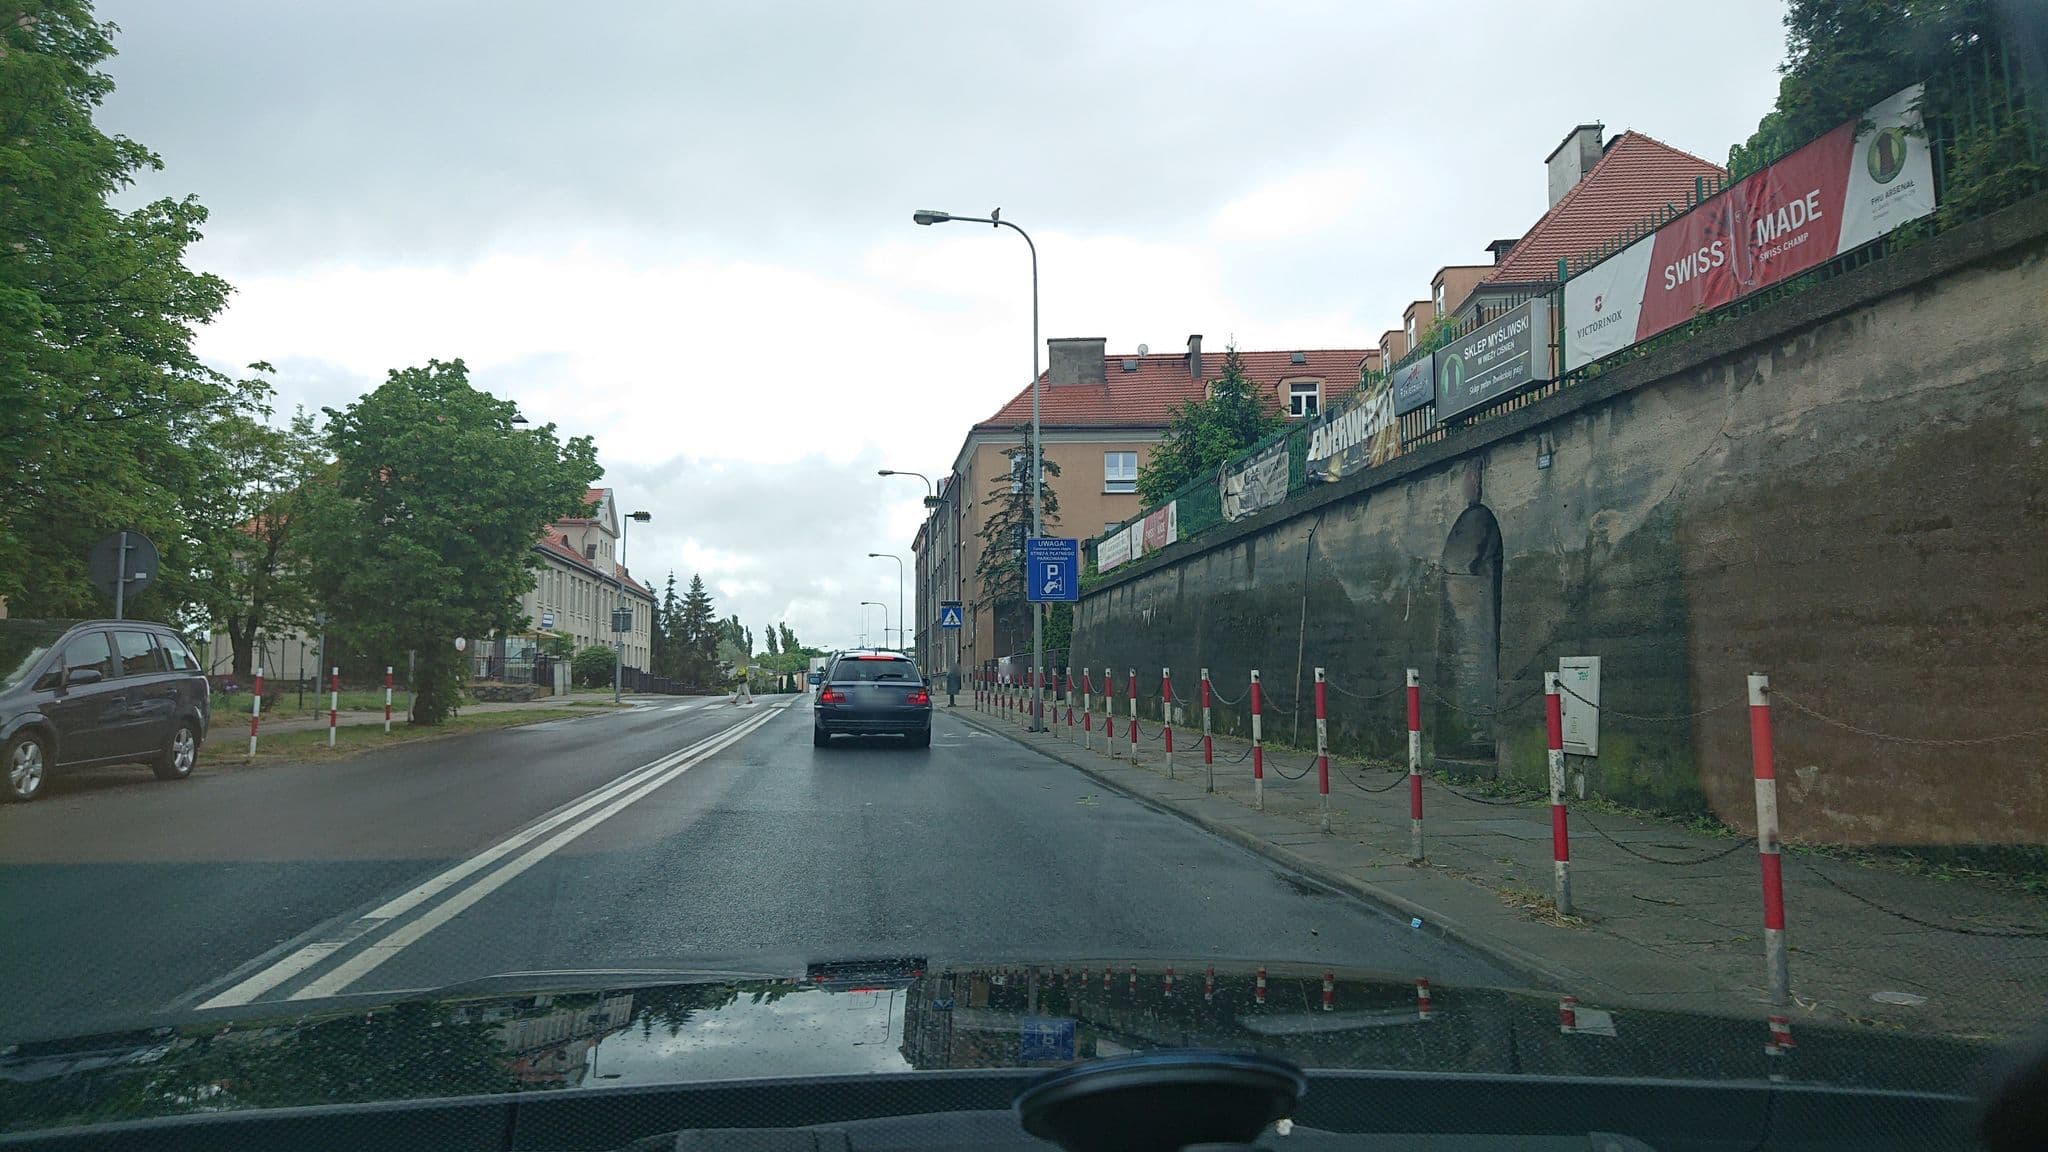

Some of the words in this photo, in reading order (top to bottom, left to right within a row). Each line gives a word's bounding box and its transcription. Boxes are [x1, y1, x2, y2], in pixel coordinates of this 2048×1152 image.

[1756, 188, 1823, 248] MADE
[1664, 240, 1725, 291] SWISS
[1759, 241, 1782, 263] SWISS
[1783, 232, 1809, 250] CHAMP
[1464, 338, 1487, 360] SKLEP
[1487, 315, 1529, 348] MYŚLIWSKI
[1577, 309, 1623, 339] VICTORINOX
[1047, 564, 1058, 580] P
